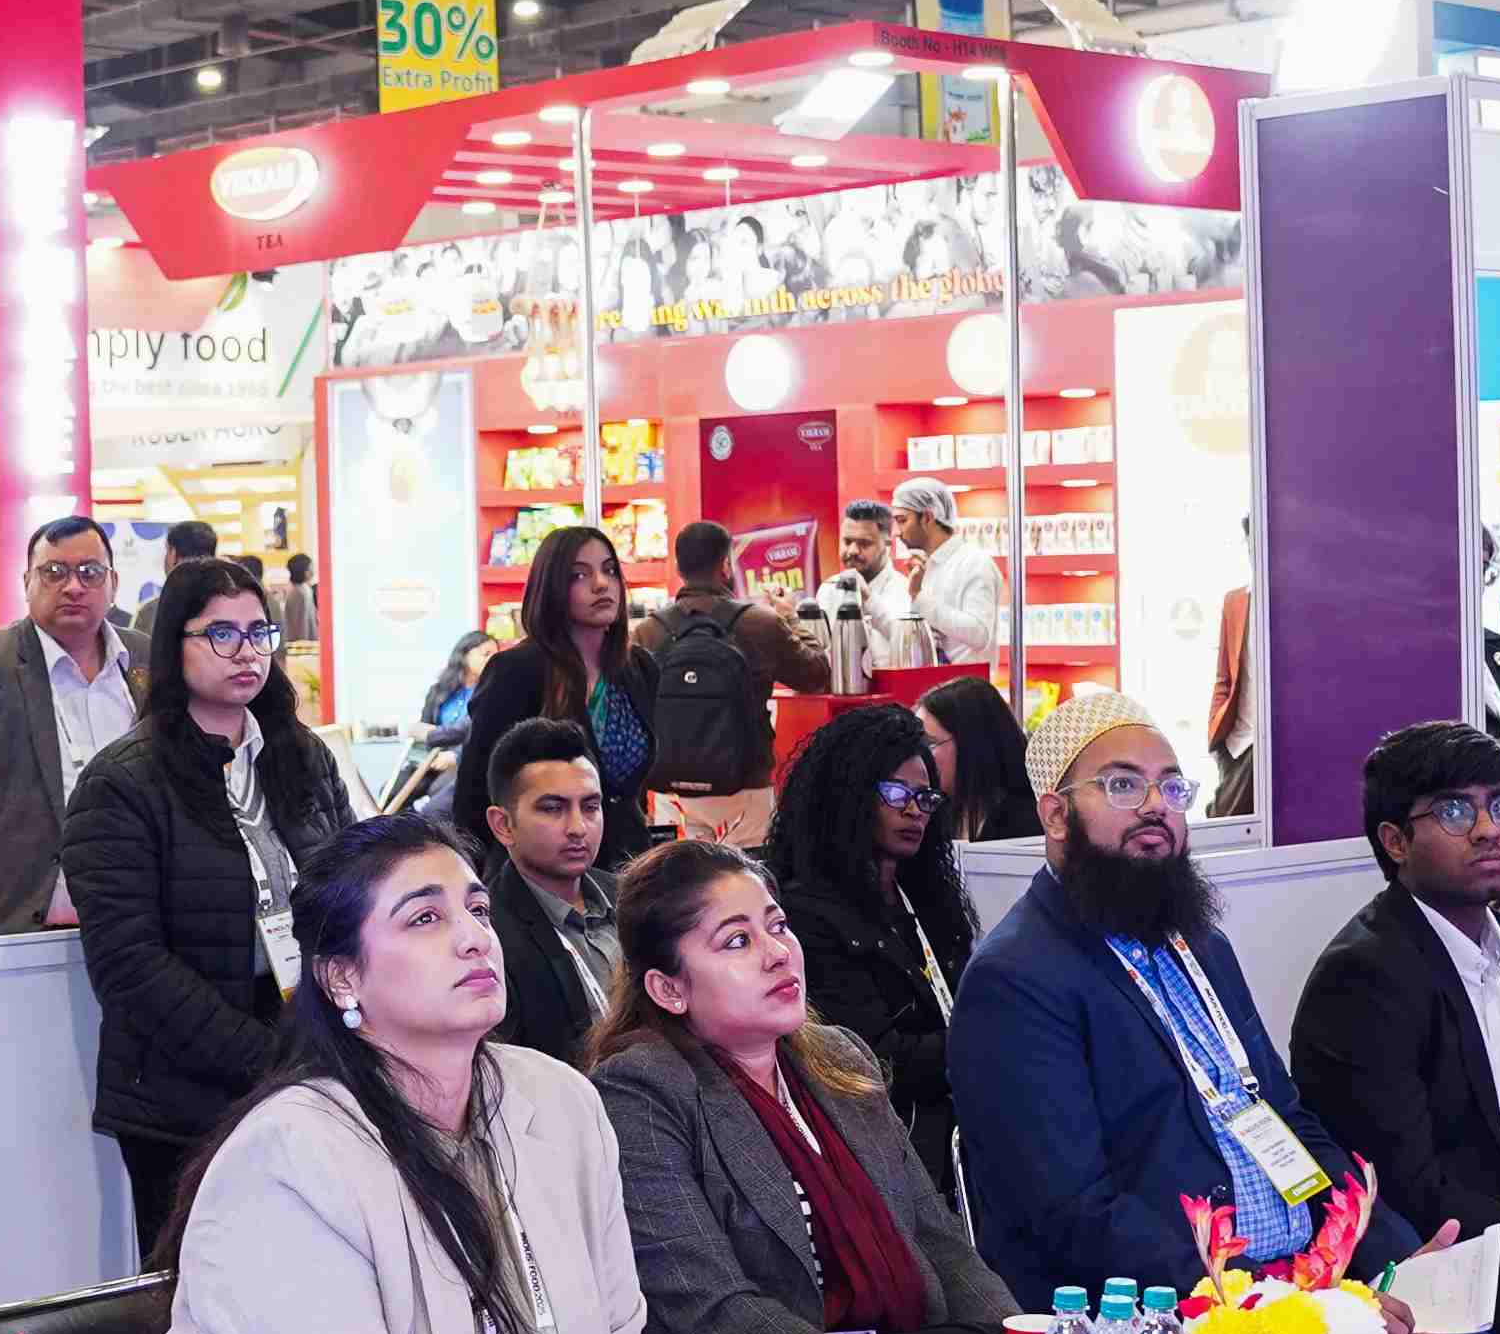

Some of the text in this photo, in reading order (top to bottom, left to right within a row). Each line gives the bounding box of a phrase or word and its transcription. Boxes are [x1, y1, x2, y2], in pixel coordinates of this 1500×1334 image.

[382, 66, 493, 94] Extra Profit
[799, 280, 884, 308] across
[890, 268, 932, 299] the
